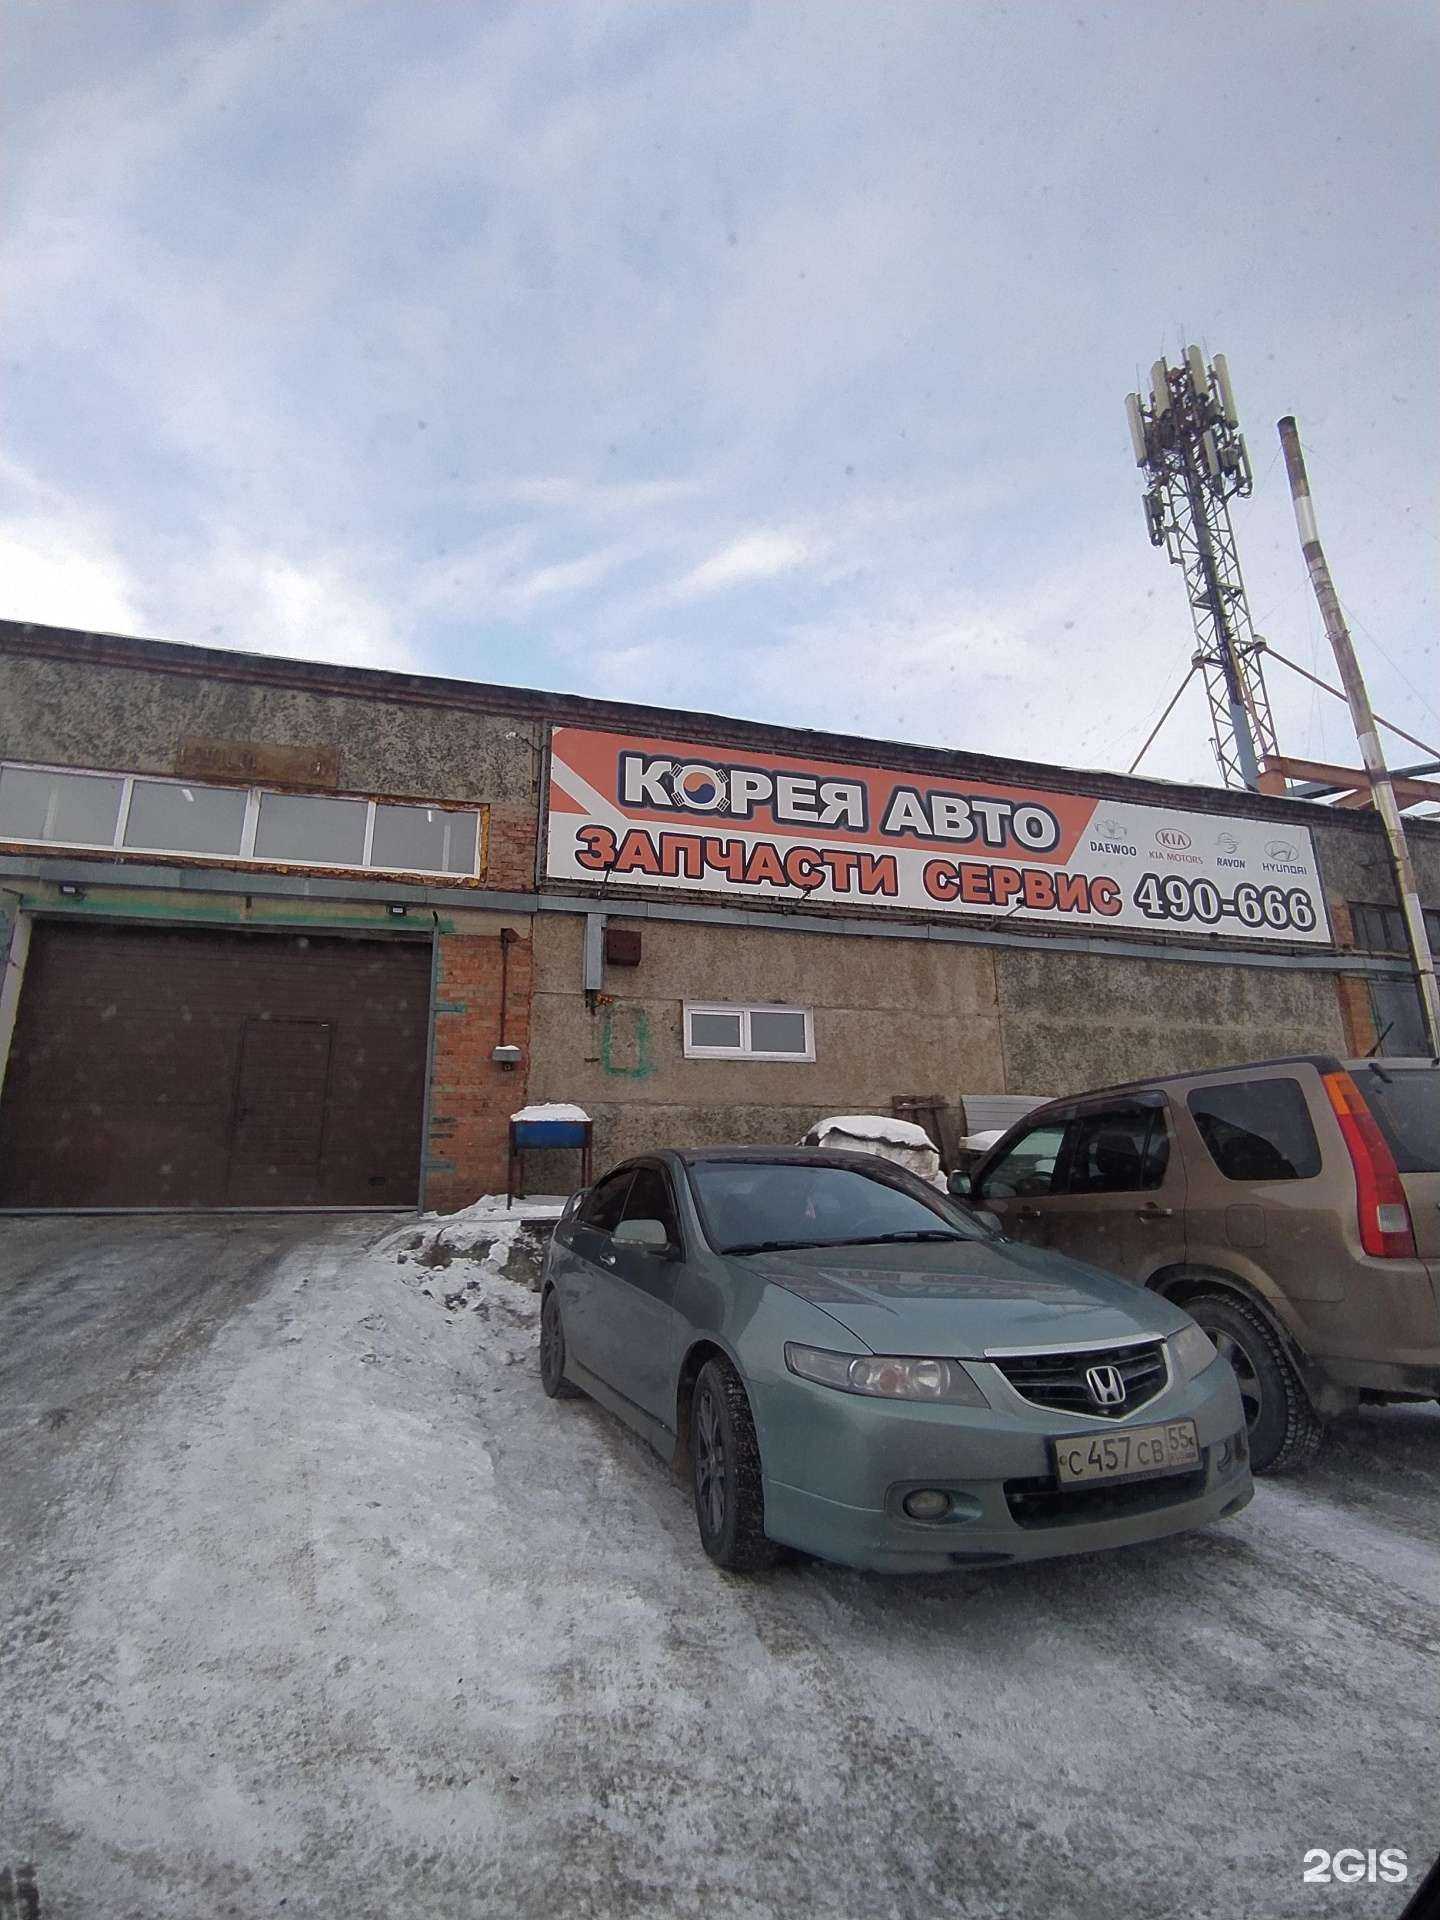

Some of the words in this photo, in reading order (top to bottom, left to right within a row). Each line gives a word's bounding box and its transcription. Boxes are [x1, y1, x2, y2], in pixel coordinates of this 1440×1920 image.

[620, 751, 867, 831] КОРЕЯ
[881, 786, 1060, 852] АВТО
[1161, 832, 1187, 846] KIA
[1090, 841, 1137, 856] DAEWOO
[1149, 850, 1165, 860] KIA
[1167, 853, 1204, 865] MOTORS
[1217, 857, 1245, 868] RAVON
[575, 825, 898, 896] ЗАПЧАСТИ
[922, 859, 1123, 915] СЕРВИС
[1262, 862, 1307, 875] HYUNDAI
[1134, 873, 1316, 930] 490-666
